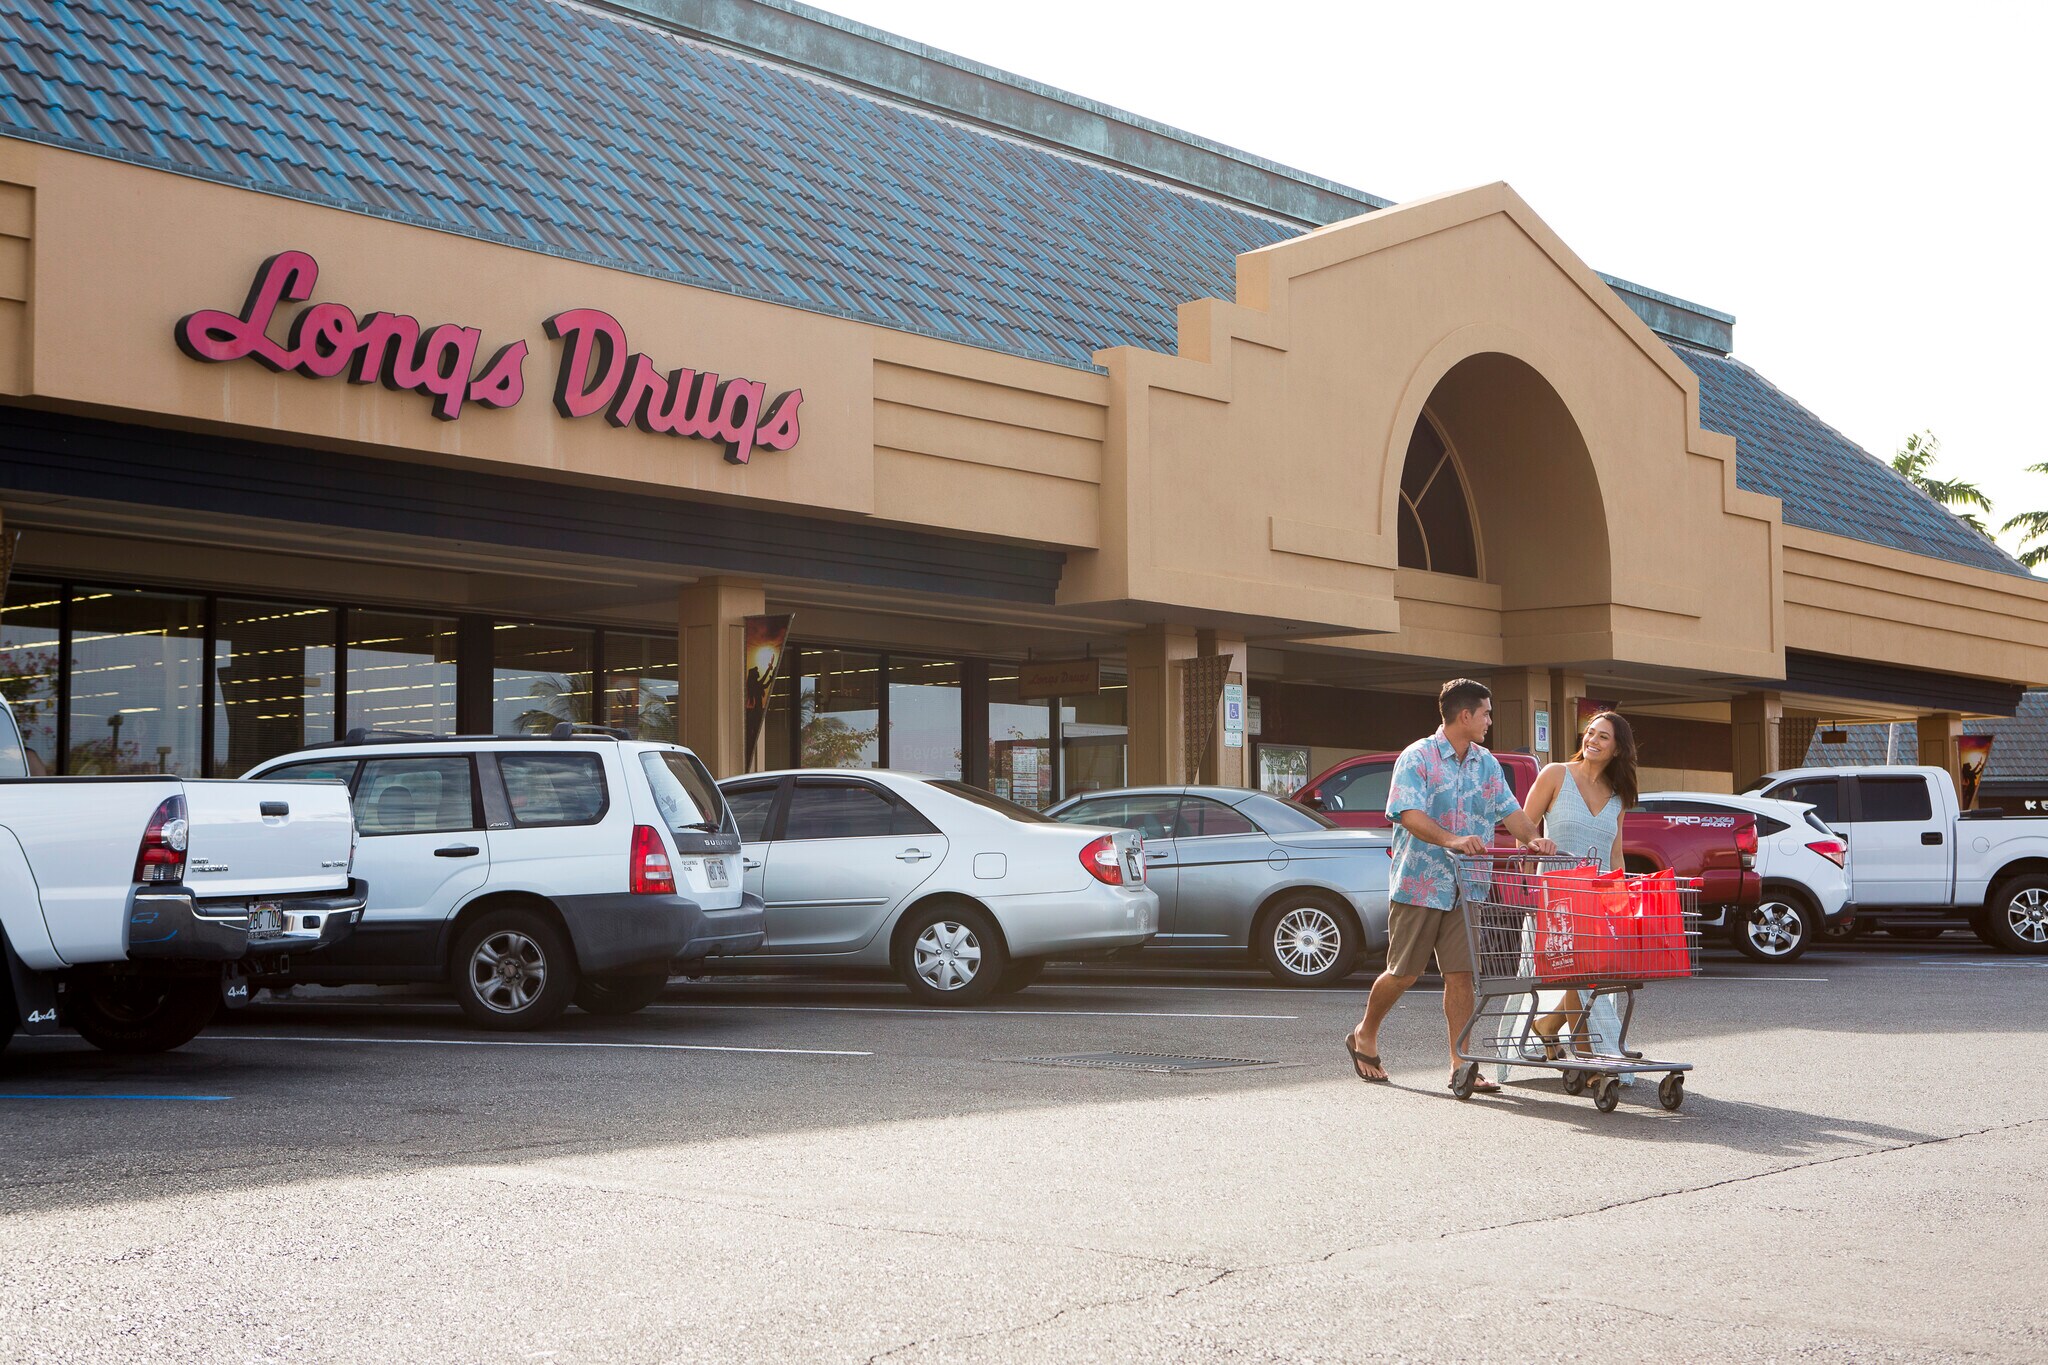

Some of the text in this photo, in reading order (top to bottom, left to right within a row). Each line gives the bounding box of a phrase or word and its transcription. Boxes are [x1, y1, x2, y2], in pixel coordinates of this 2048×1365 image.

[174, 250, 804, 465] Longs Drugs
[1028, 671, 1089, 686] Longs Drugs
[1663, 815, 1700, 825] TRD
[190, 864, 229, 873] TACOMA
[249, 910, 281, 930] ZBC 702
[227, 984, 248, 997] 4x4
[28, 1007, 57, 1023] 4x4
